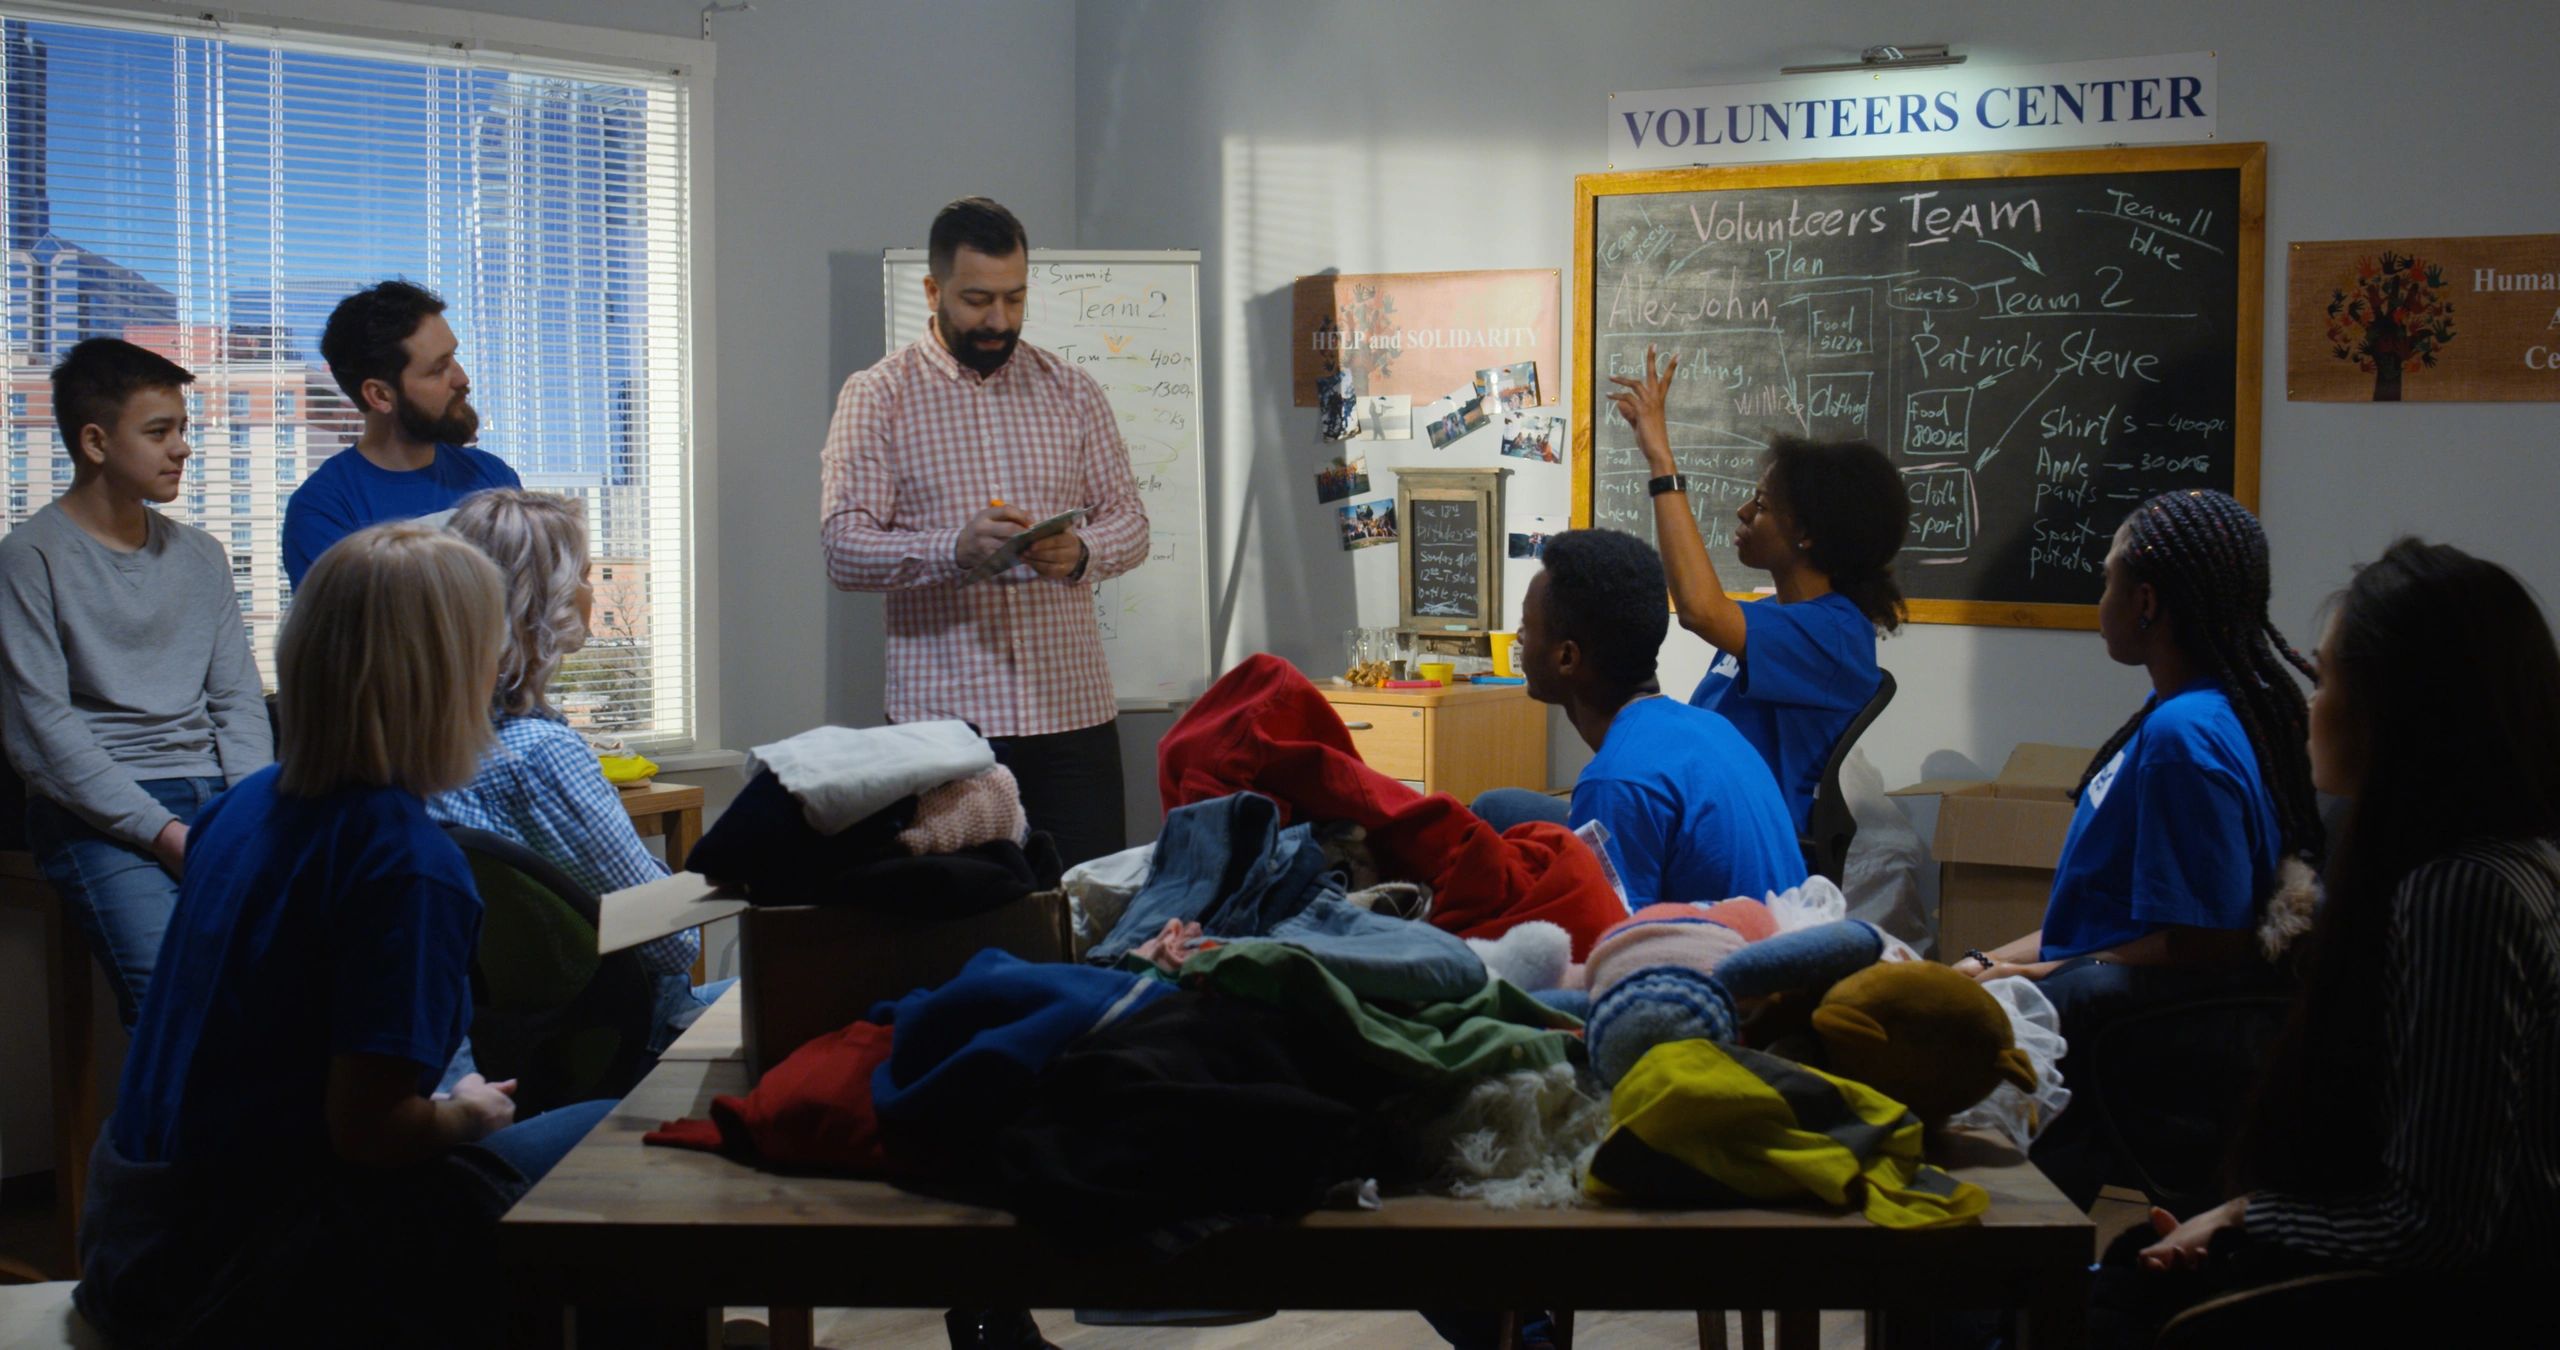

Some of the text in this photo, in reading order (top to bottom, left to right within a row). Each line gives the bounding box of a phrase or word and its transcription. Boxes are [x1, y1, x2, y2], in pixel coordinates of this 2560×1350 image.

[1623, 74, 2207, 149] VOLUNTEERS CENTER
[1689, 197, 1886, 244] Volunteers
[2106, 187, 2182, 227] Team
[1765, 240, 1824, 280] Plan
[2129, 226, 2184, 271] blue
[1049, 263, 1113, 285] Summit
[1972, 265, 2135, 315] Team 2
[2472, 267, 2560, 292] Huma
[1058, 285, 1141, 322] Team
[1312, 326, 1541, 351] HELP and SOLIDARITY
[2054, 326, 2162, 384] Steve
[2035, 445, 2089, 483] Apple
